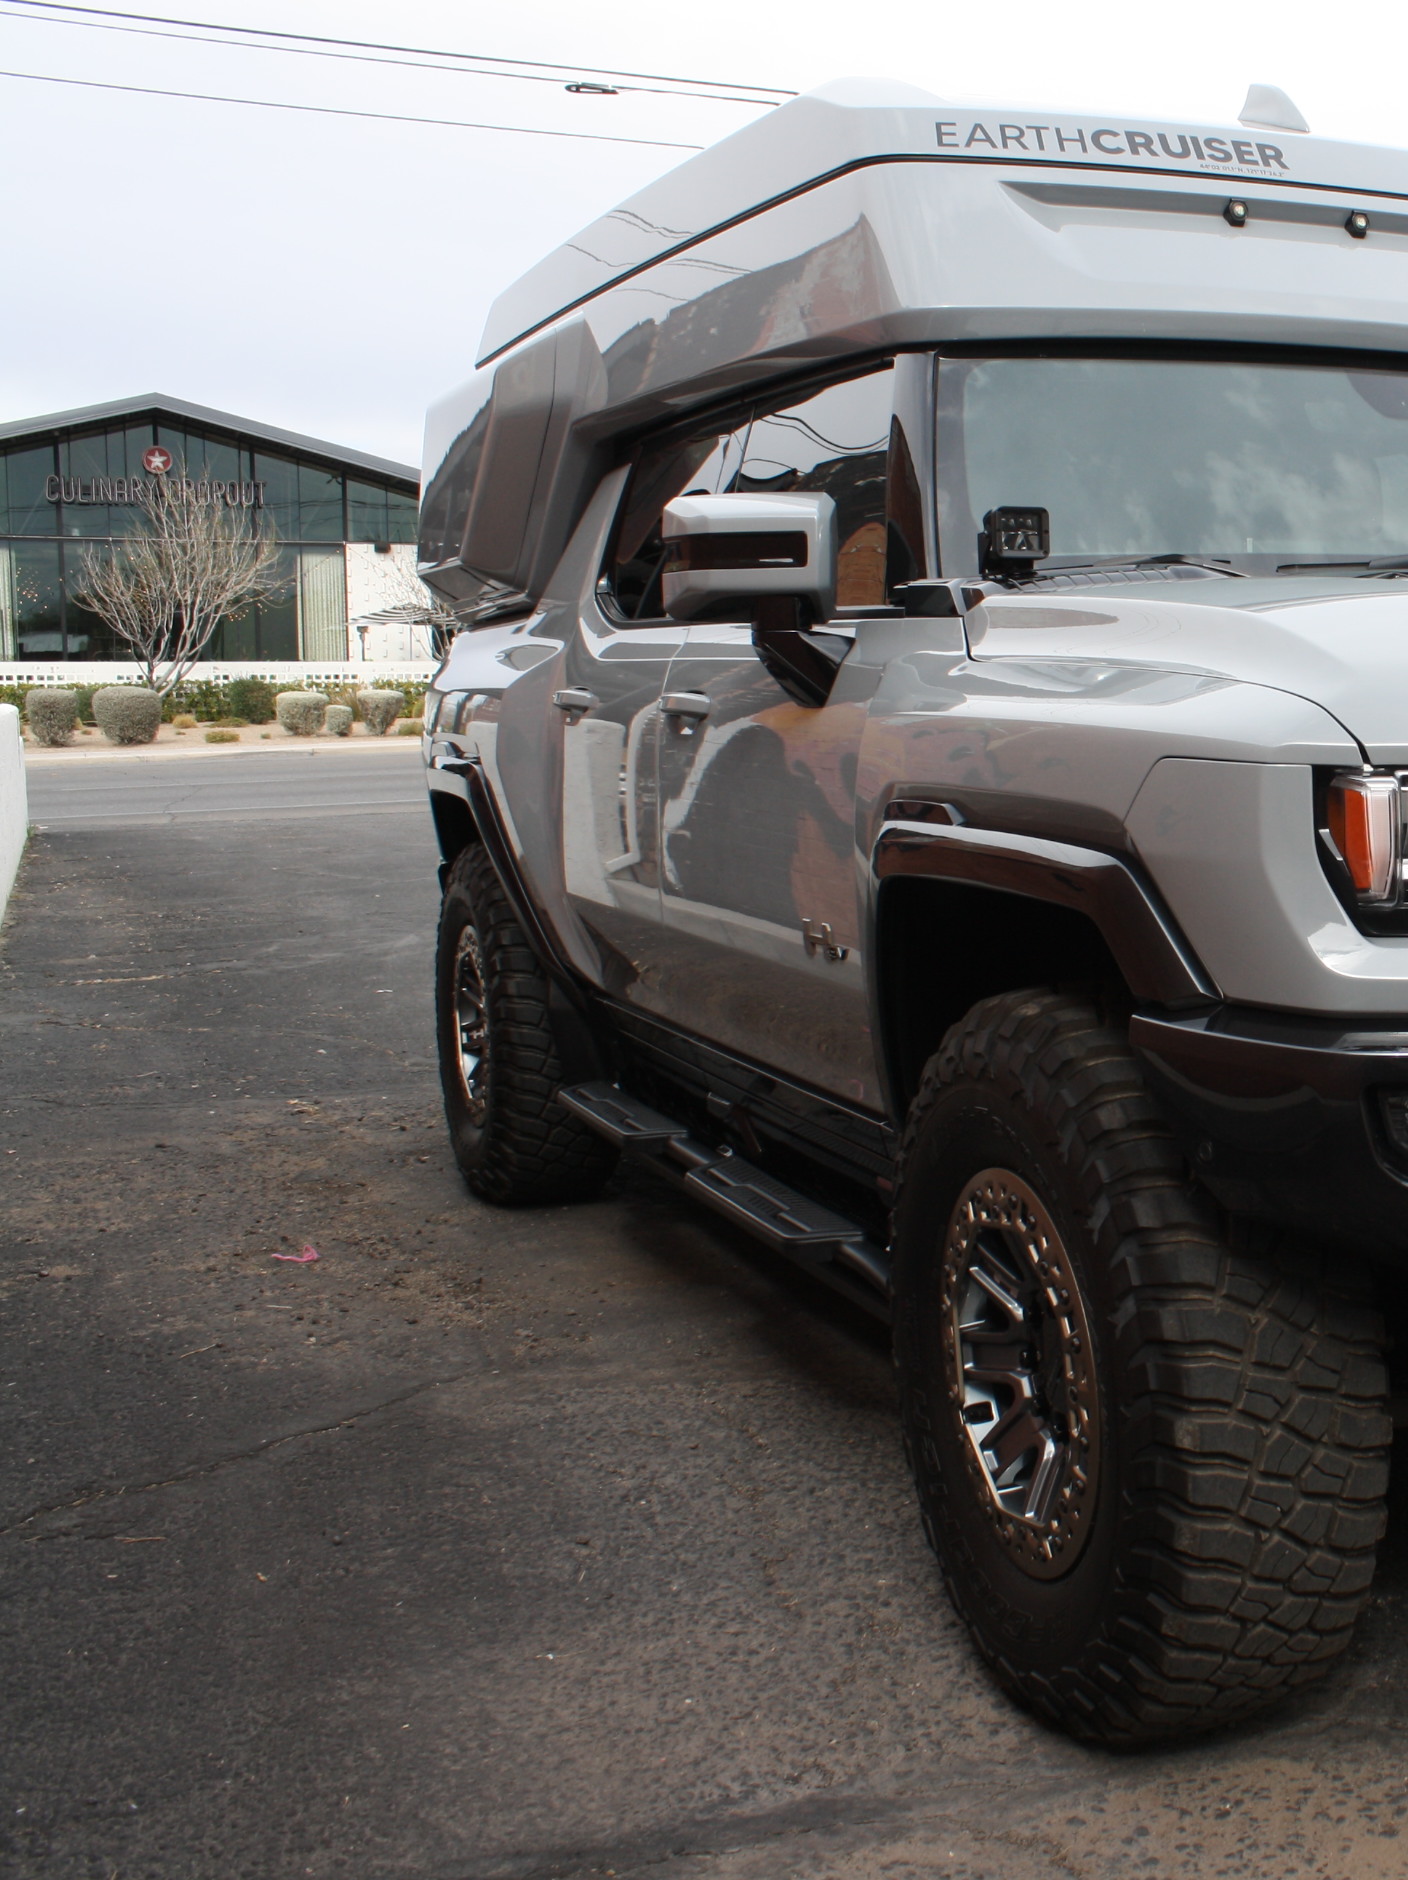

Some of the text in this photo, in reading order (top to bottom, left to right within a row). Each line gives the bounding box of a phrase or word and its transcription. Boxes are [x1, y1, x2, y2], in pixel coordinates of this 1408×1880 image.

[935, 121, 1290, 170] EARTHCRUISER
[45, 474, 266, 508] CULINARY DROPOUT
